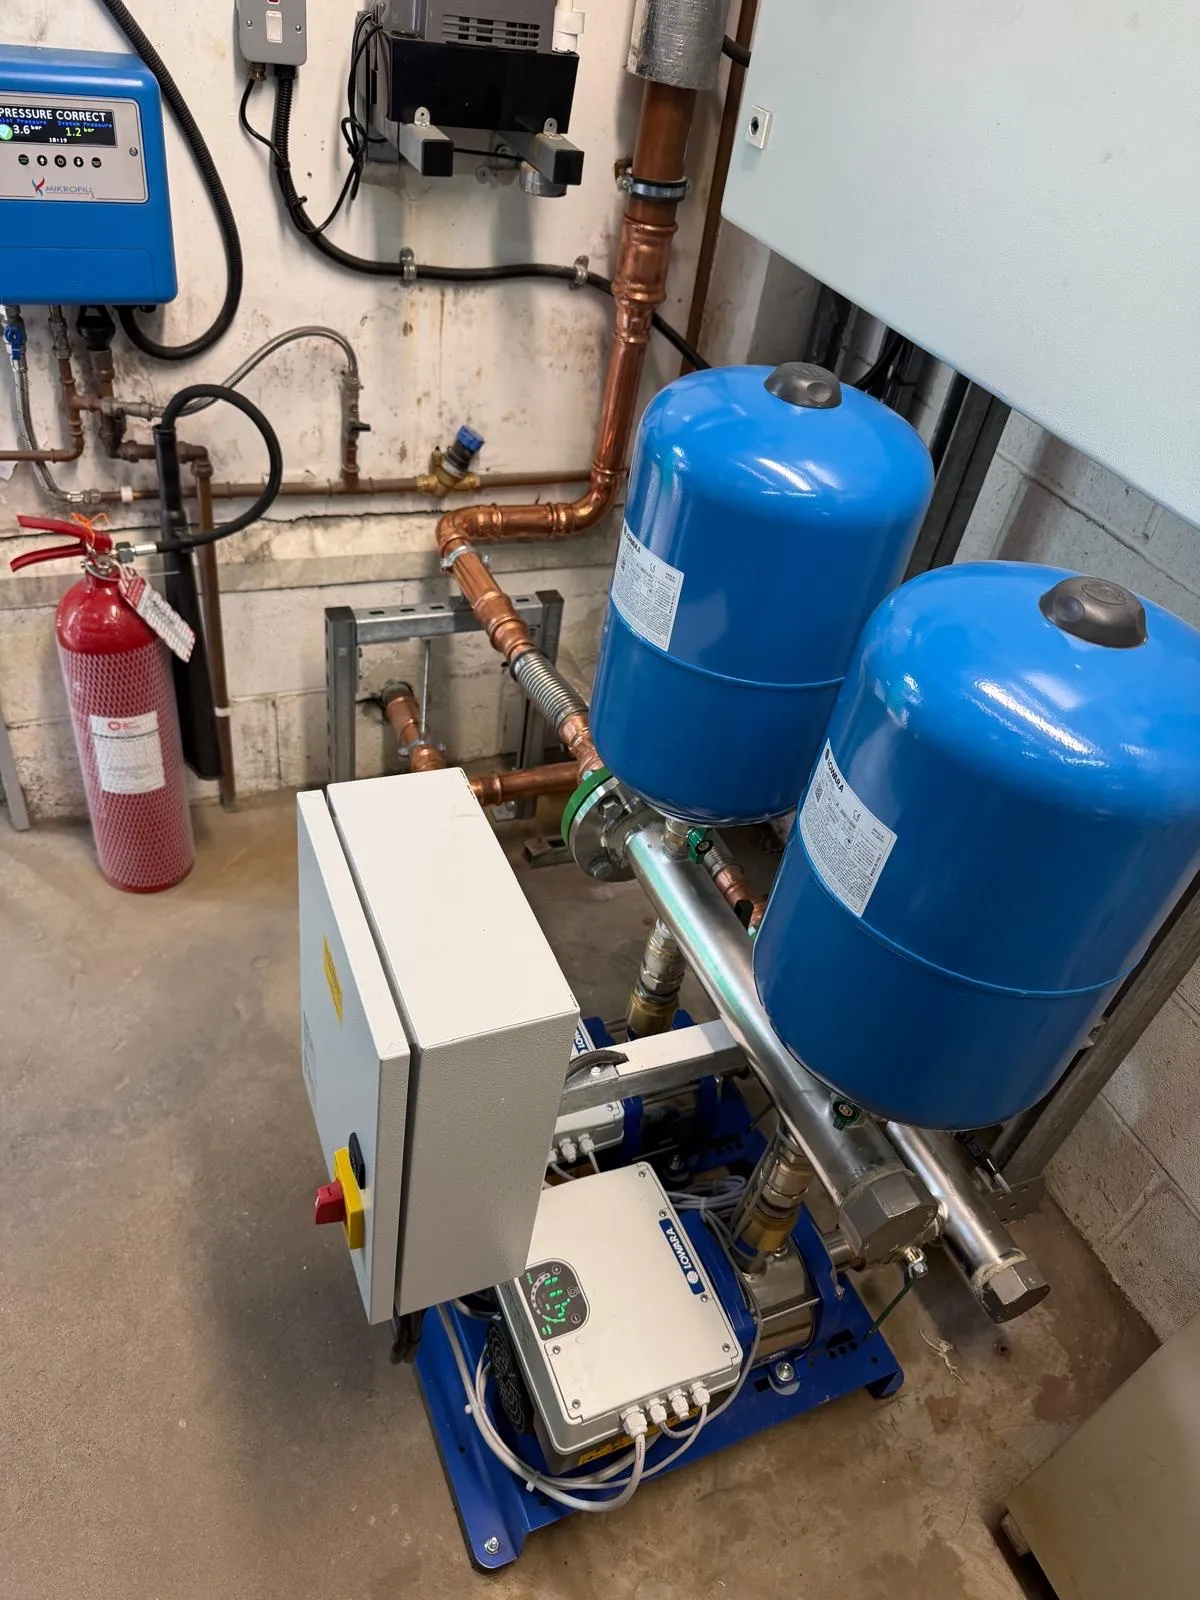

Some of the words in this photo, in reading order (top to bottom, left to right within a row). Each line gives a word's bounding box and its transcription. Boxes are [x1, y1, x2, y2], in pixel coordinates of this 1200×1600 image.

[0, 108, 53, 119] PRESSURE
[56, 110, 106, 122] CORRECT
[13, 124, 30, 134] 3.6
[65, 127, 81, 137] 1.2
[827, 758, 844, 793] LOWARA
[665, 1227, 692, 1269] LOWARA
